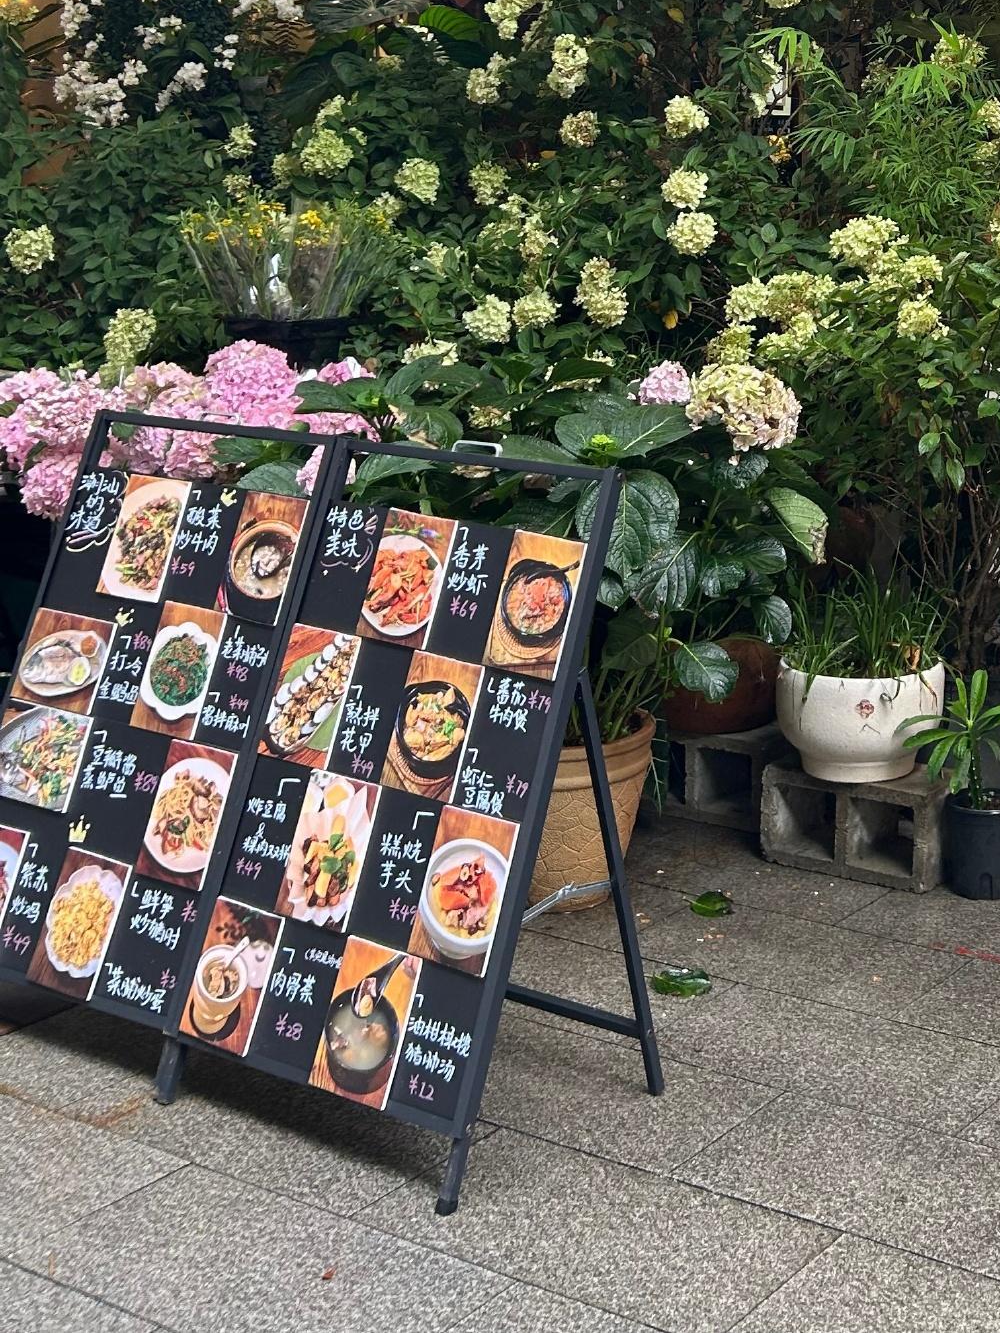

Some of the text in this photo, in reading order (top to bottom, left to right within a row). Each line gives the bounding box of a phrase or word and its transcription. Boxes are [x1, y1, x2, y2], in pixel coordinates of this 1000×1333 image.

[77, 471, 119, 496] 潮汕
[85, 495, 104, 512] 的
[186, 504, 223, 530] 酸菜
[326, 505, 365, 531] 特色
[64, 506, 105, 535] 味道
[175, 528, 219, 556] 炒牛肉
[324, 528, 362, 558] 美味
[447, 570, 489, 596] 炒虾
[109, 651, 143, 678] 打冷
[345, 699, 380, 730] 熟拌
[489, 704, 529, 733] 牛肉煲
[340, 727, 373, 754] 花甲
[90, 744, 138, 776] 豆瓣酱
[461, 766, 495, 788] 虾仁
[246, 797, 288, 823] 炸豆腐
[462, 786, 506, 818] 豆腐煲
[379, 832, 427, 864] 糕烧
[19, 861, 49, 893] 紫苏
[379, 861, 413, 894] 芋头
[9, 895, 41, 924] 炒鸡
[139, 889, 175, 920] 鲜笋
[269, 967, 316, 1006] 肉骨茶
[404, 1042, 456, 1083] 猪肺汤
